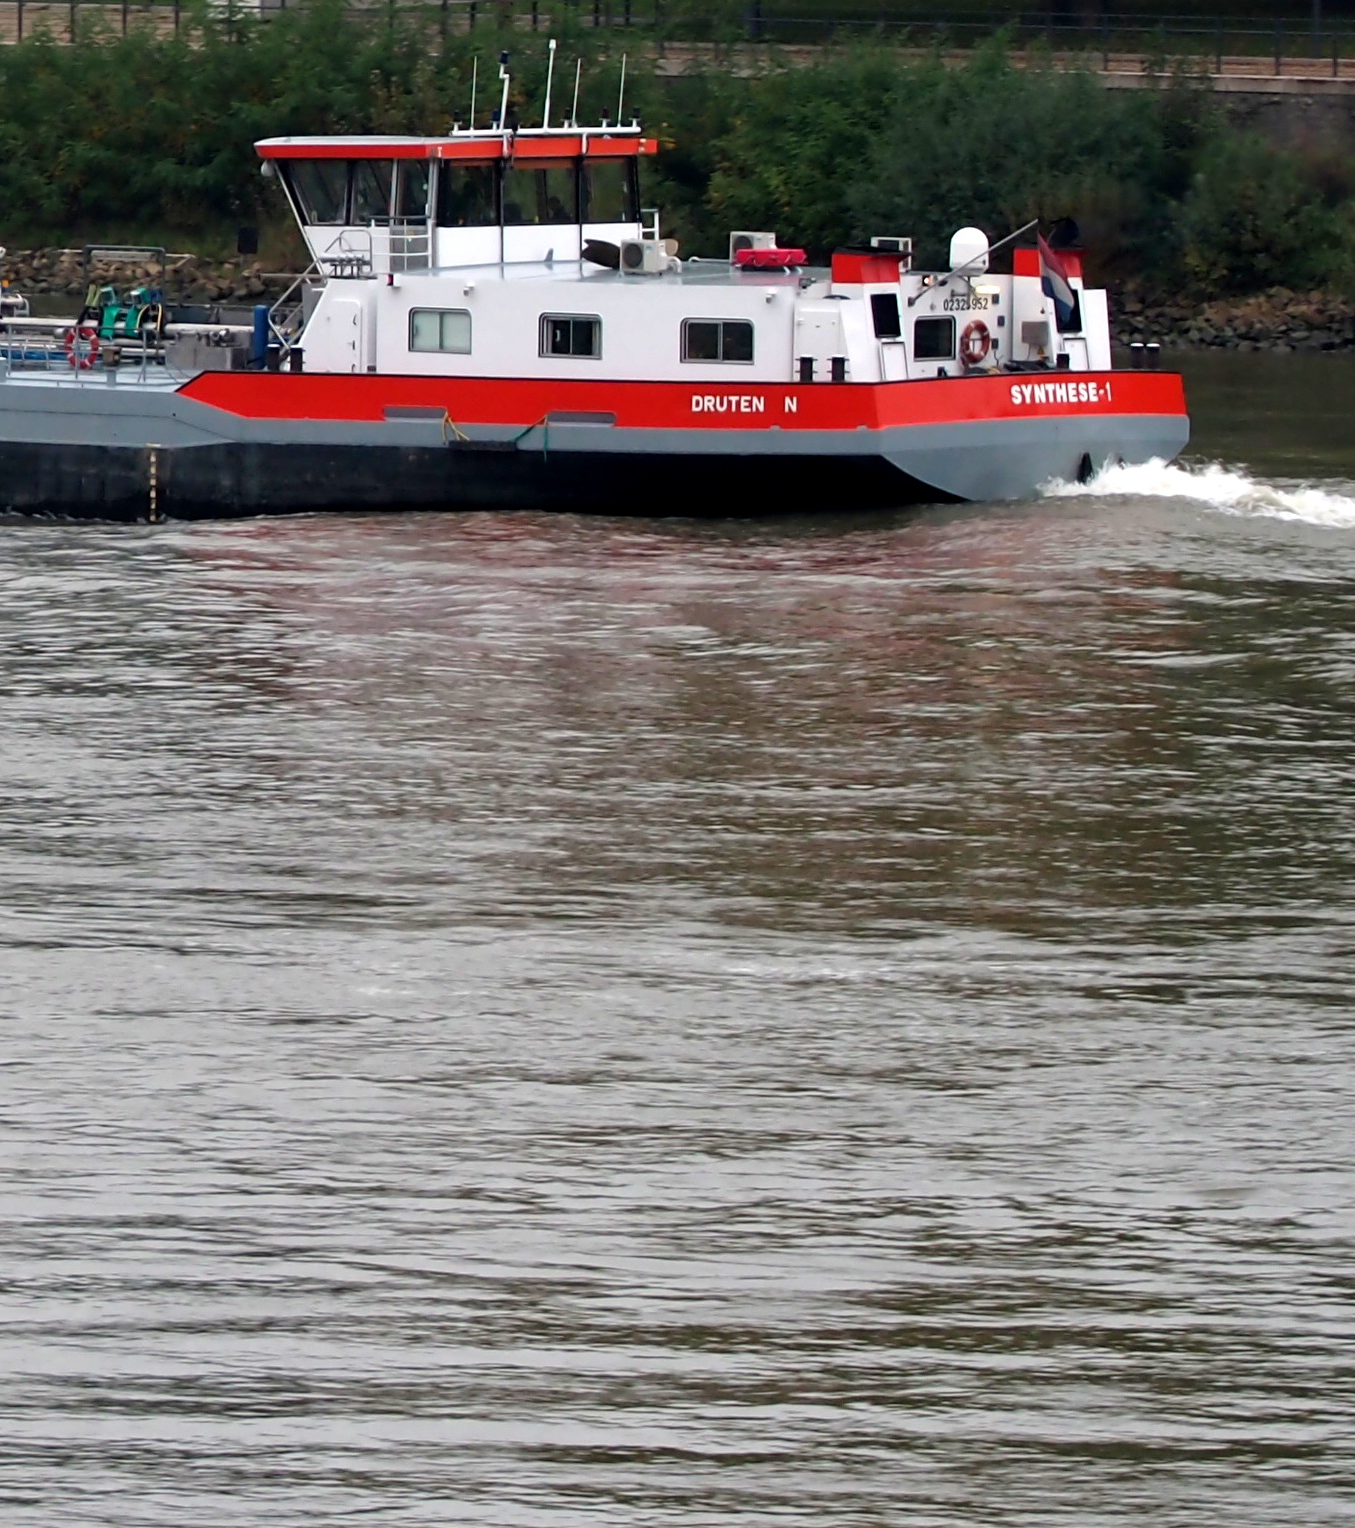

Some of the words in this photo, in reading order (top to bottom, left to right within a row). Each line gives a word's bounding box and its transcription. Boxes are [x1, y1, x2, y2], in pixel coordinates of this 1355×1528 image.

[943, 297, 988, 311] 0232952
[1011, 381, 1112, 405] SYNTHESE-1
[691, 395, 765, 413] DRUTEN
[784, 396, 798, 413] N
